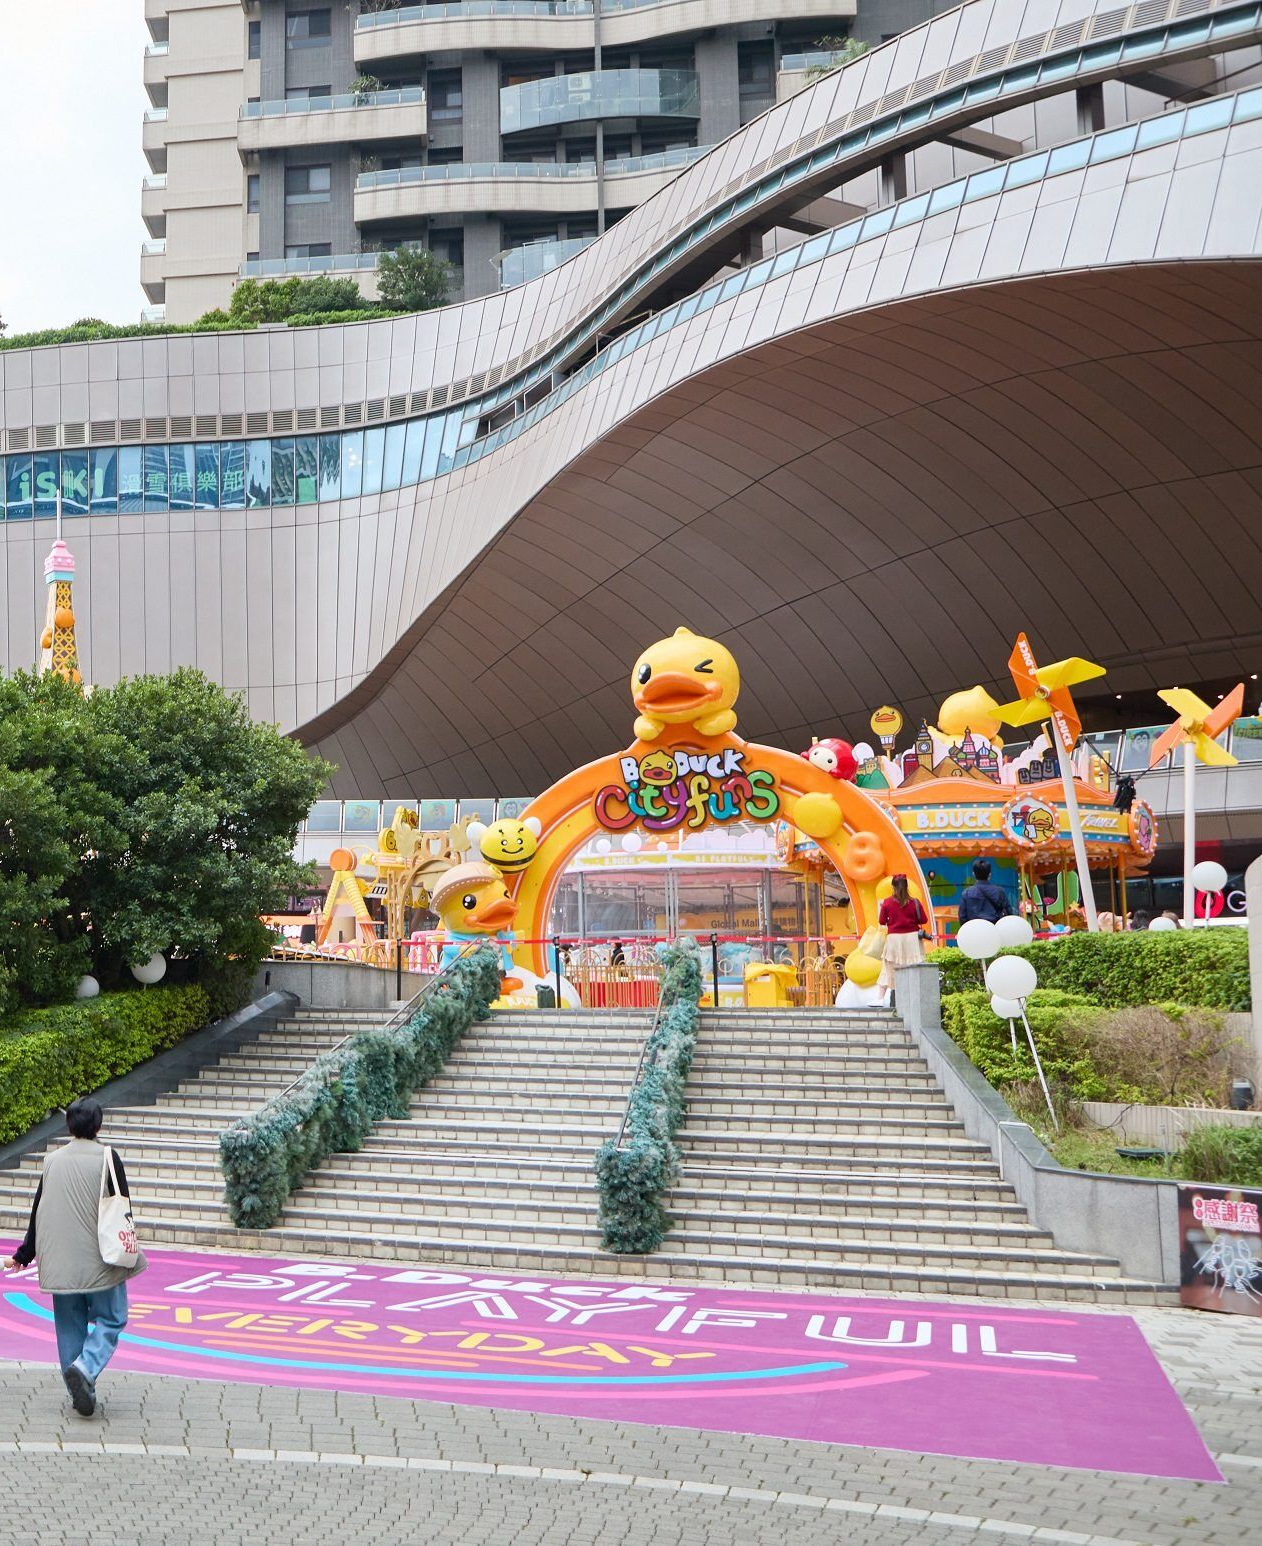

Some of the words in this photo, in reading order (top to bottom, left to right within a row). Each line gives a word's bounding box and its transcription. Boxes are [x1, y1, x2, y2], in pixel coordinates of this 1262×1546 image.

[19, 466, 104, 500] iSKI
[916, 811, 991, 829] B.DUCK
[1204, 1200, 1258, 1224] 感謝祭
